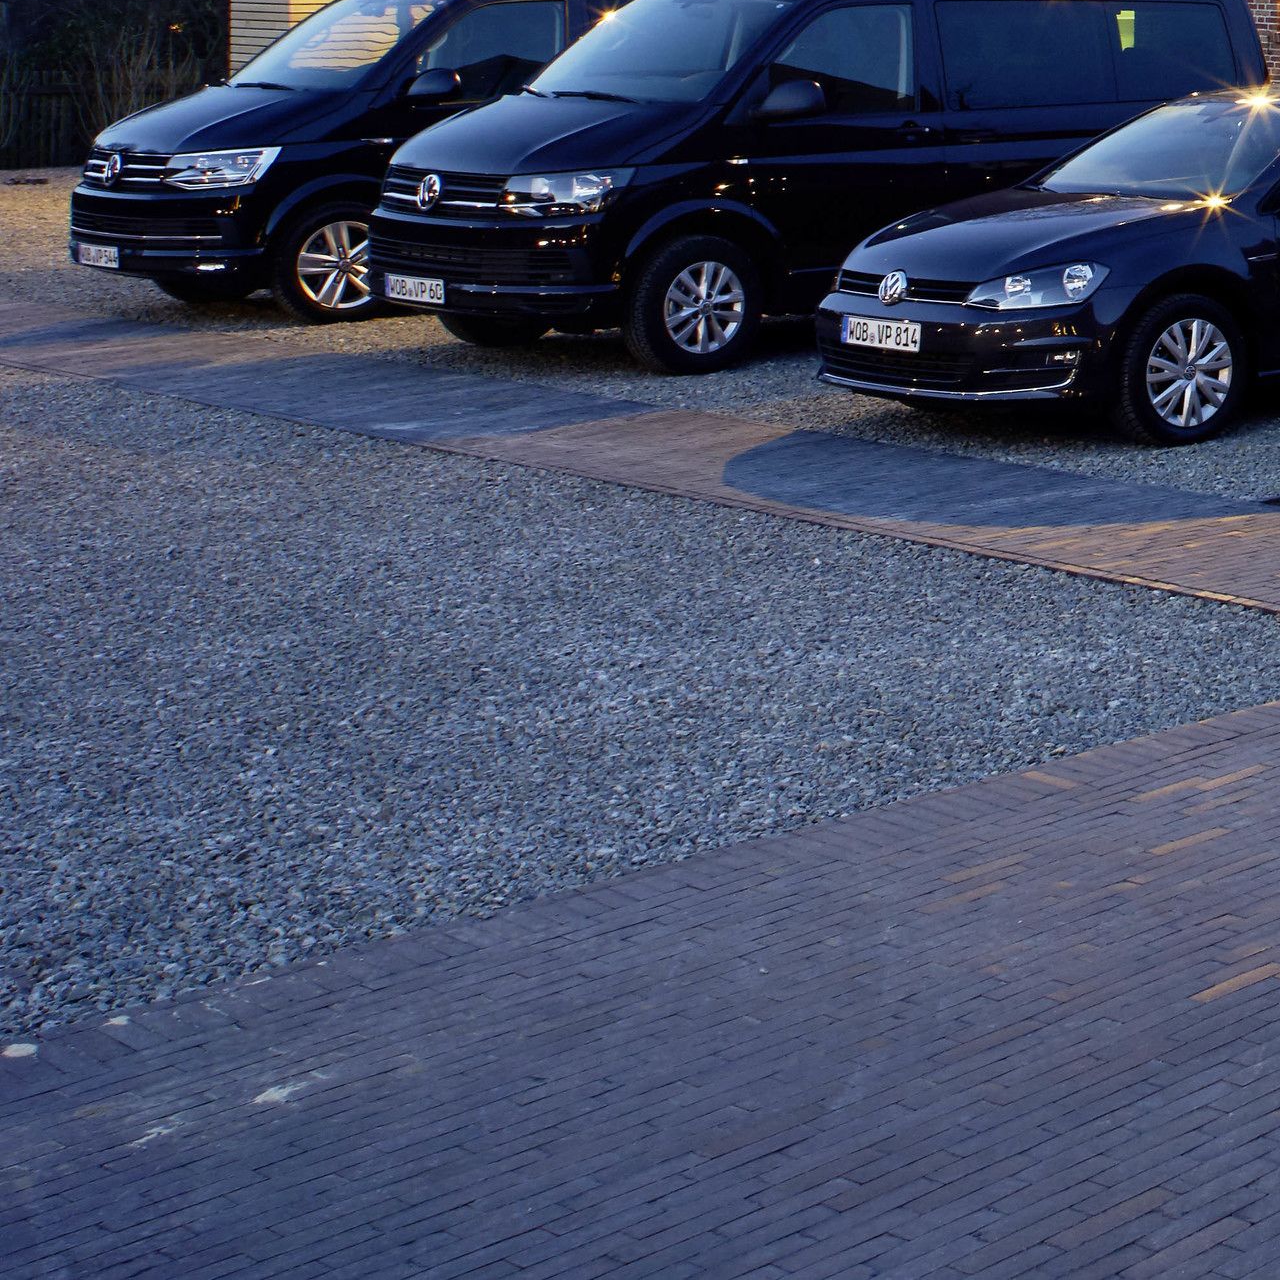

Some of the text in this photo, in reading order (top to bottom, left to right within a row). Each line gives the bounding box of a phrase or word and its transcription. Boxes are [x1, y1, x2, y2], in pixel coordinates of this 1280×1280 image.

[390, 278, 407, 296] WOB
[413, 280, 427, 298] VP
[849, 320, 918, 348] WOB VP 814
